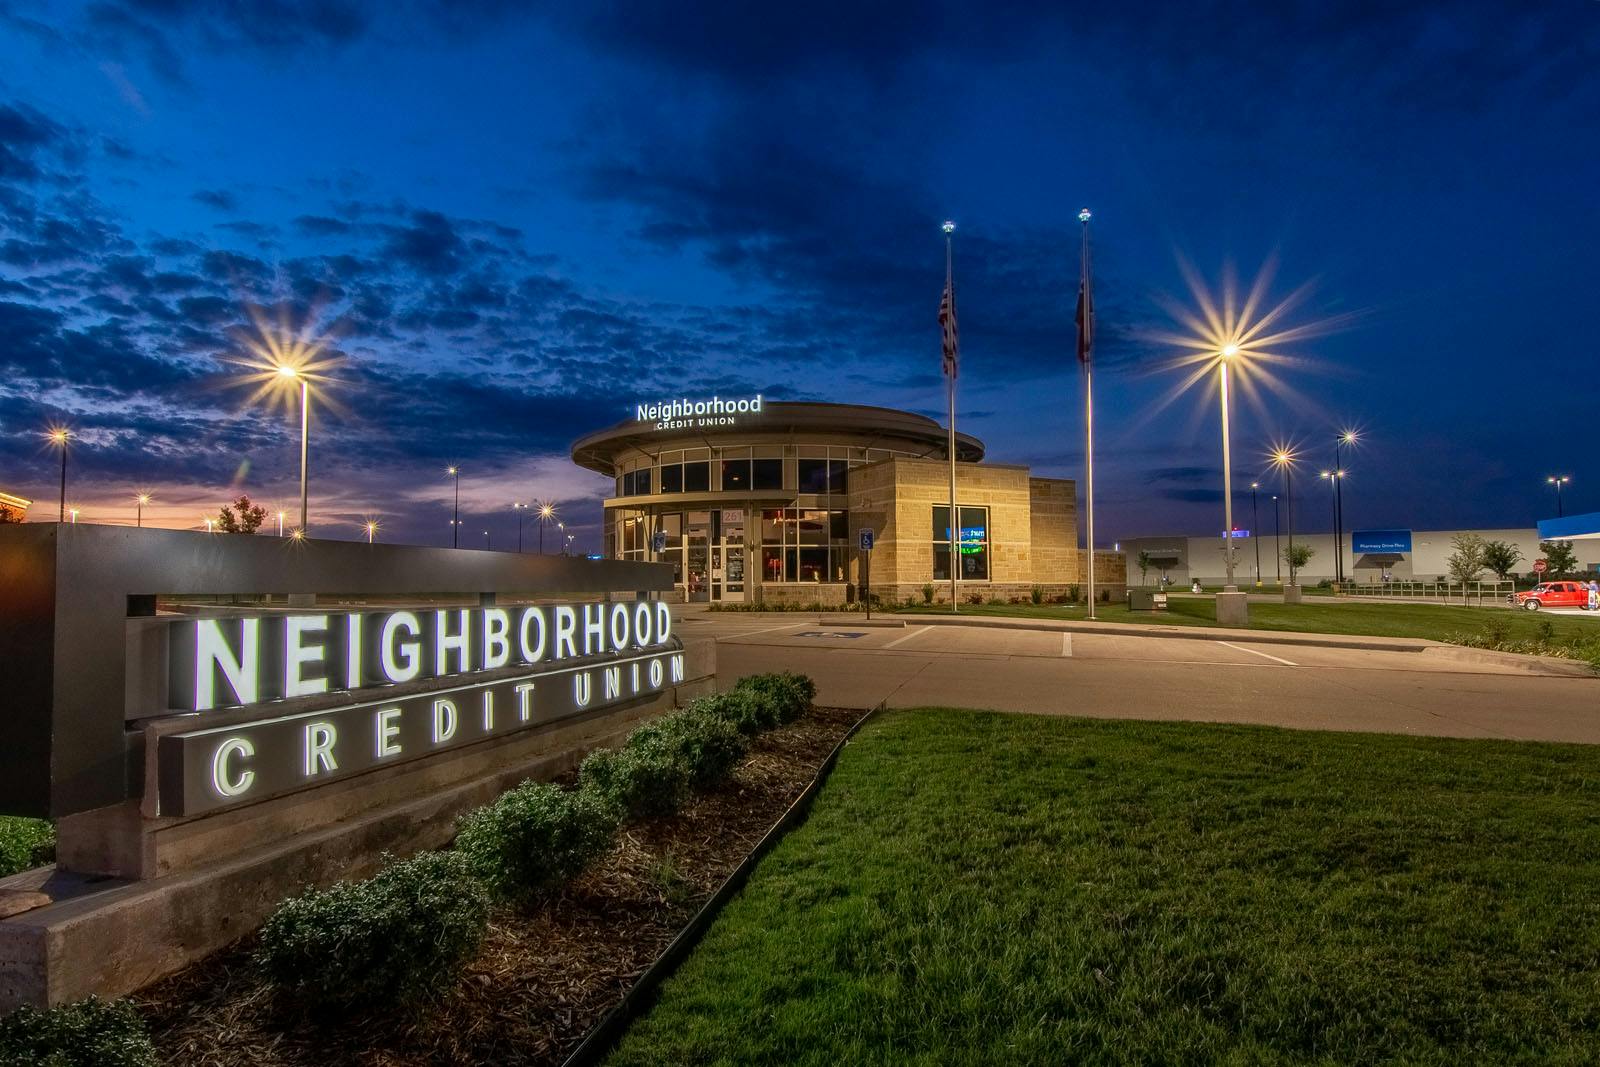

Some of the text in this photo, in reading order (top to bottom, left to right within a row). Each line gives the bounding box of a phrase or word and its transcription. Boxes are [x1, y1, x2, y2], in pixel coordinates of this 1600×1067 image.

[637, 394, 762, 421] Neighborhood
[657, 416, 735, 430] CREDIT UNION
[194, 602, 671, 711] NEIGHBORHOOD
[211, 653, 685, 798] CREDIT UNION
